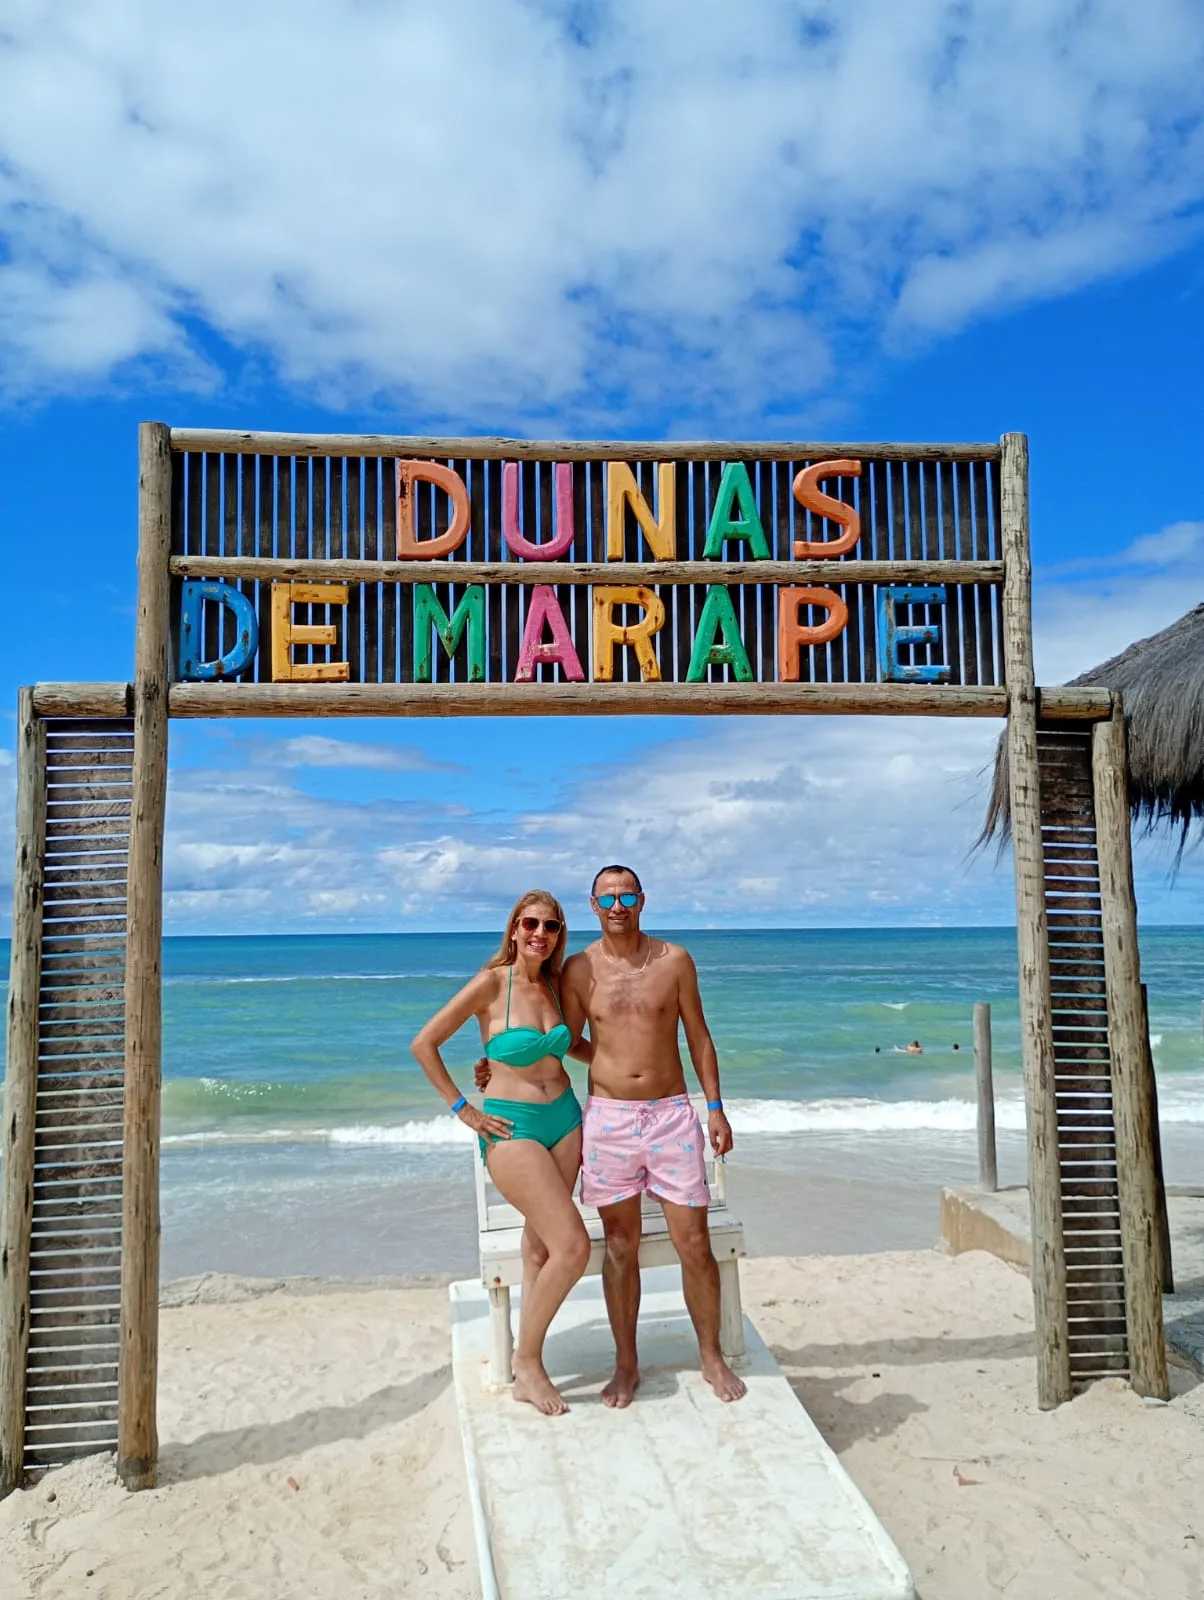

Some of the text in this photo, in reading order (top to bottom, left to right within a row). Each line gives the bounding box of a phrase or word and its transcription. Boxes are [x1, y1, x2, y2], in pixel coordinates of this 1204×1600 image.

[397, 459, 862, 561] DUNAS
[179, 580, 952, 683] DE MARAPE
